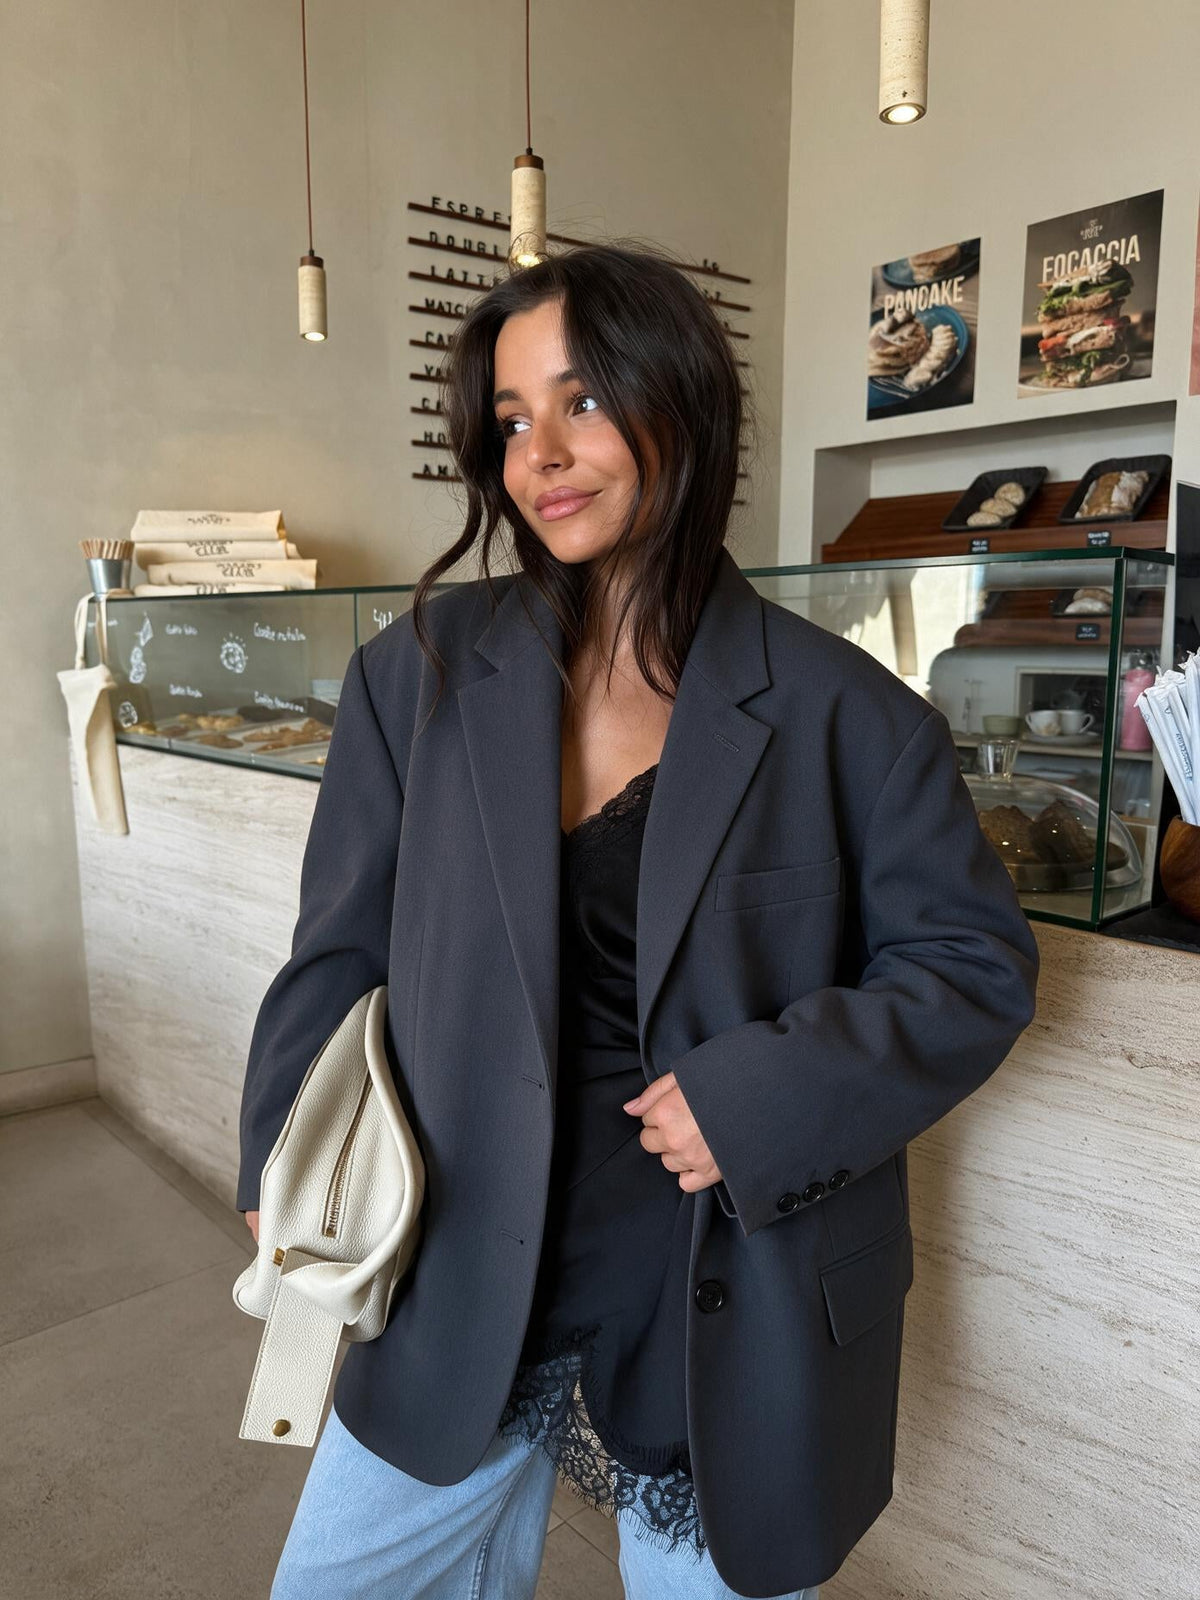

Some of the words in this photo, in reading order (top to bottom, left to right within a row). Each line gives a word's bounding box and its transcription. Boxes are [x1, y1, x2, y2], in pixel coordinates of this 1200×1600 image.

[429, 231, 511, 260] DOUBL
[1042, 234, 1141, 283] FOCACCIA
[884, 275, 965, 321] PANCAKE
